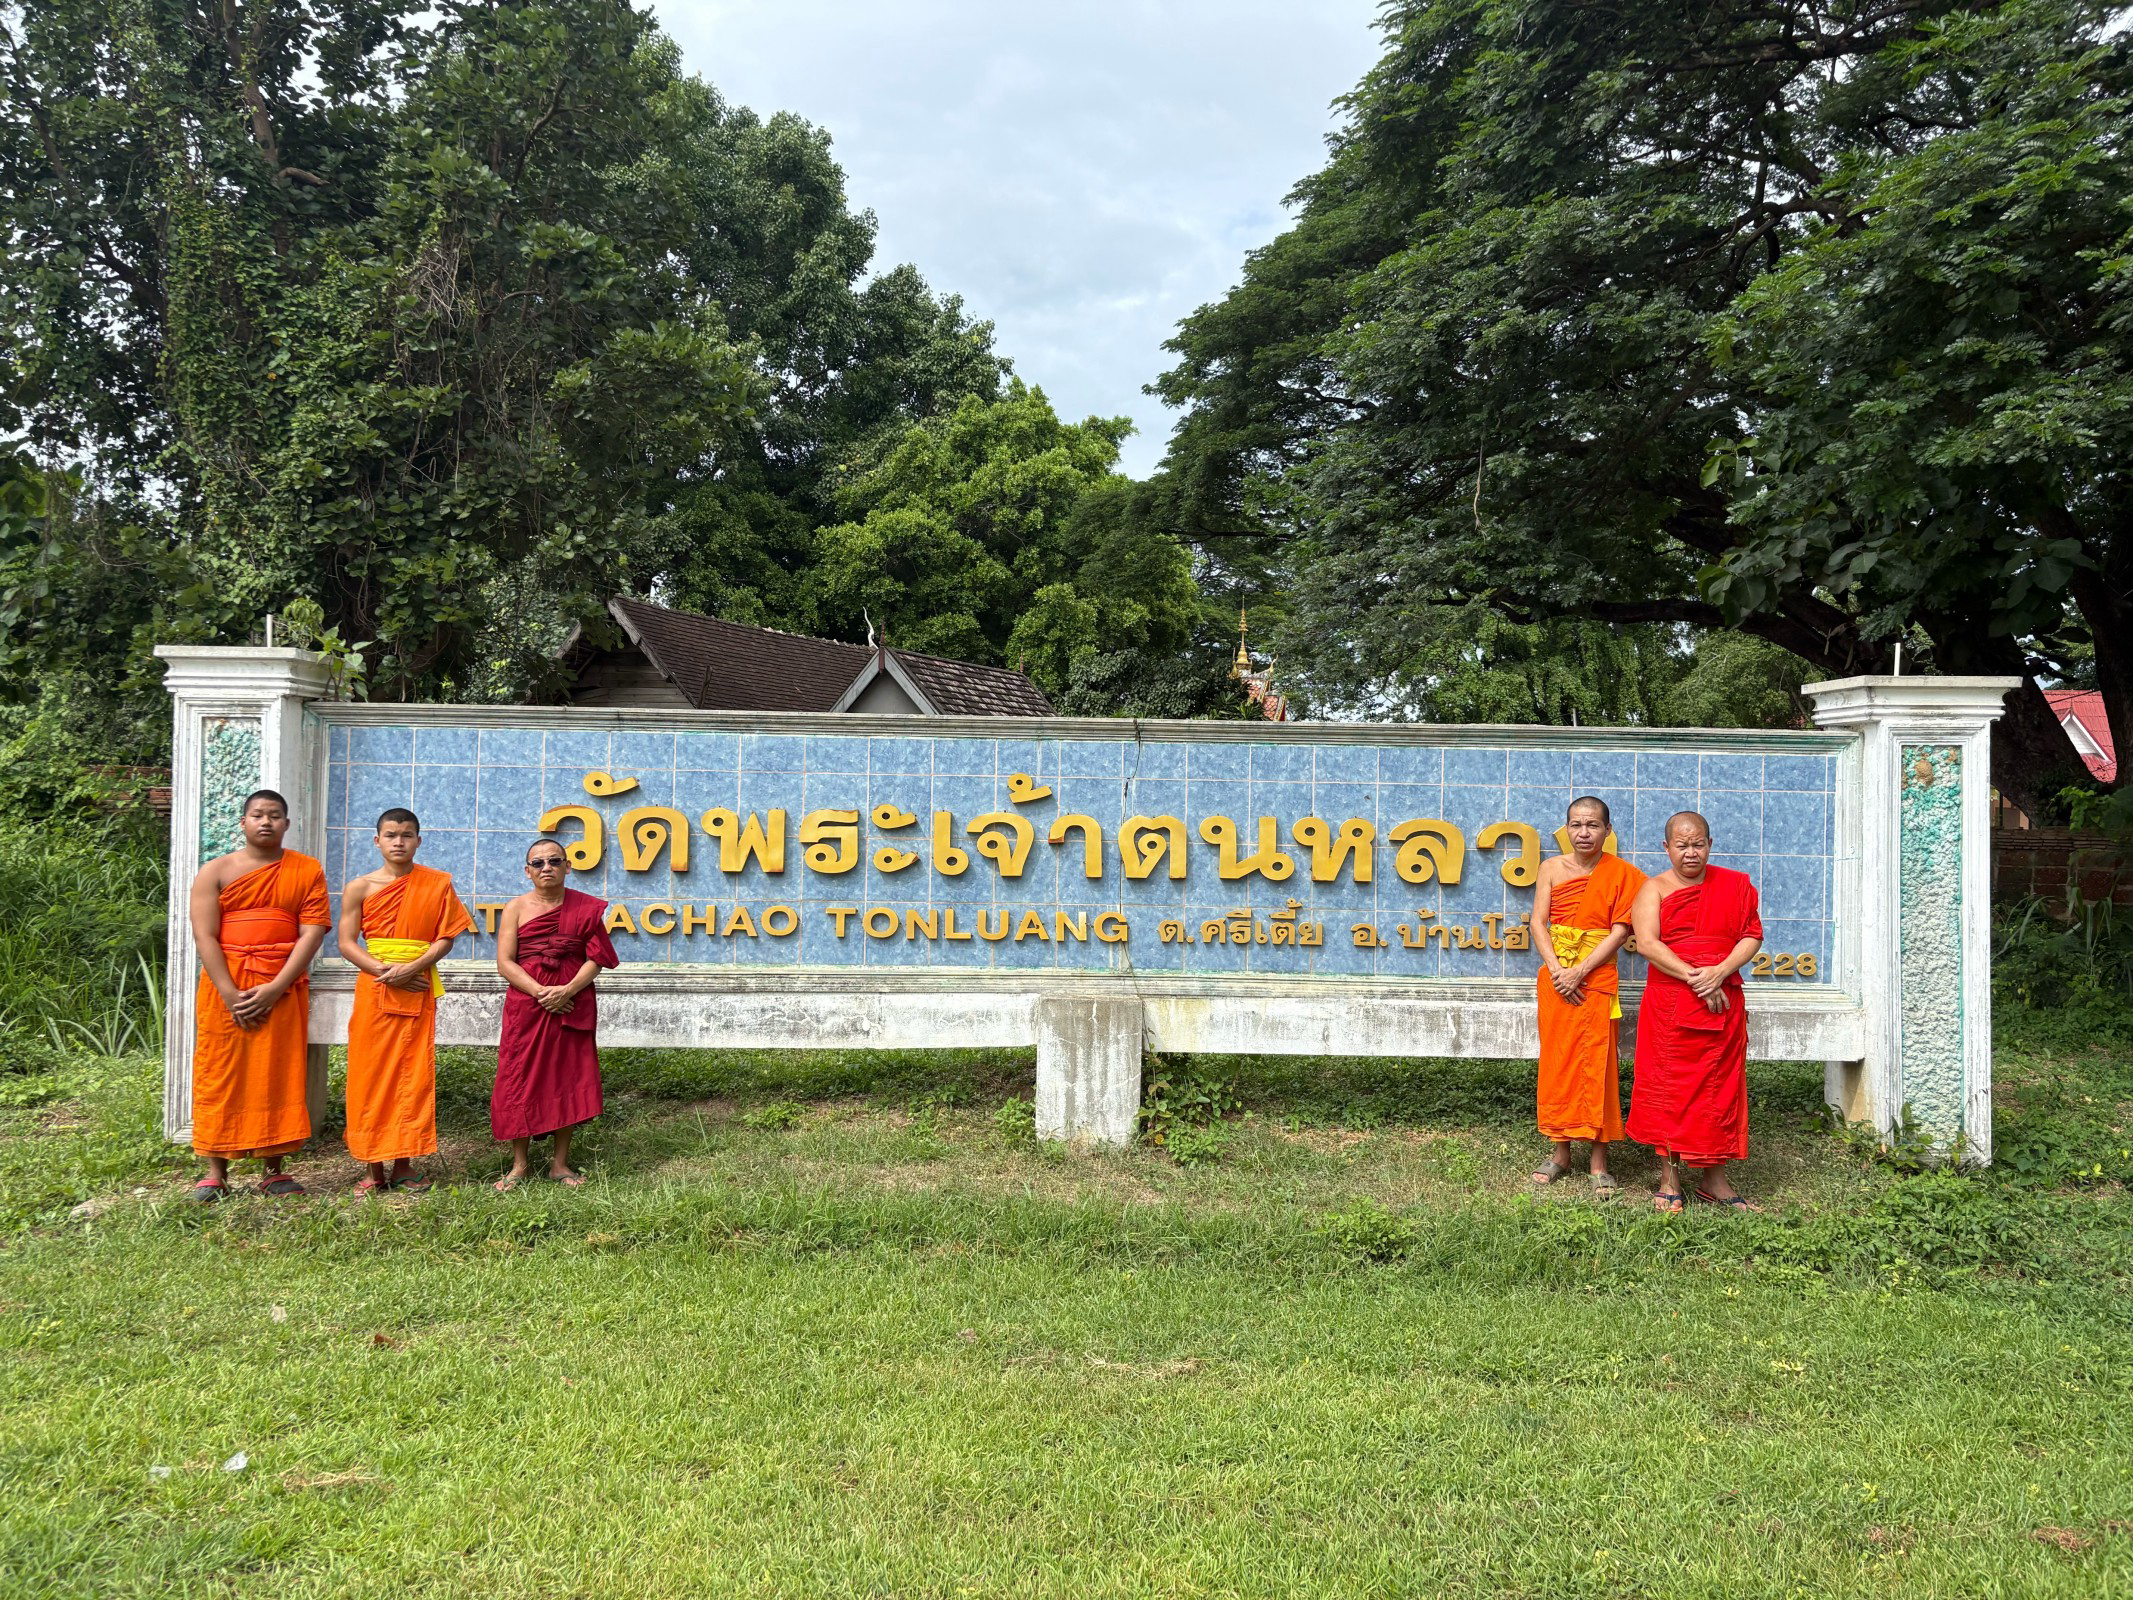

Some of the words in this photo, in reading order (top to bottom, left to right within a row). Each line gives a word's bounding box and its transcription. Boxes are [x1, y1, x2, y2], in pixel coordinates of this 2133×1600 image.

[606, 903, 799, 937] ACHAO
[825, 907, 1128, 943] TONLUANG
[1157, 897, 1323, 946] ต.ศรีเตี้ย
[1750, 952, 1818, 977] 228
